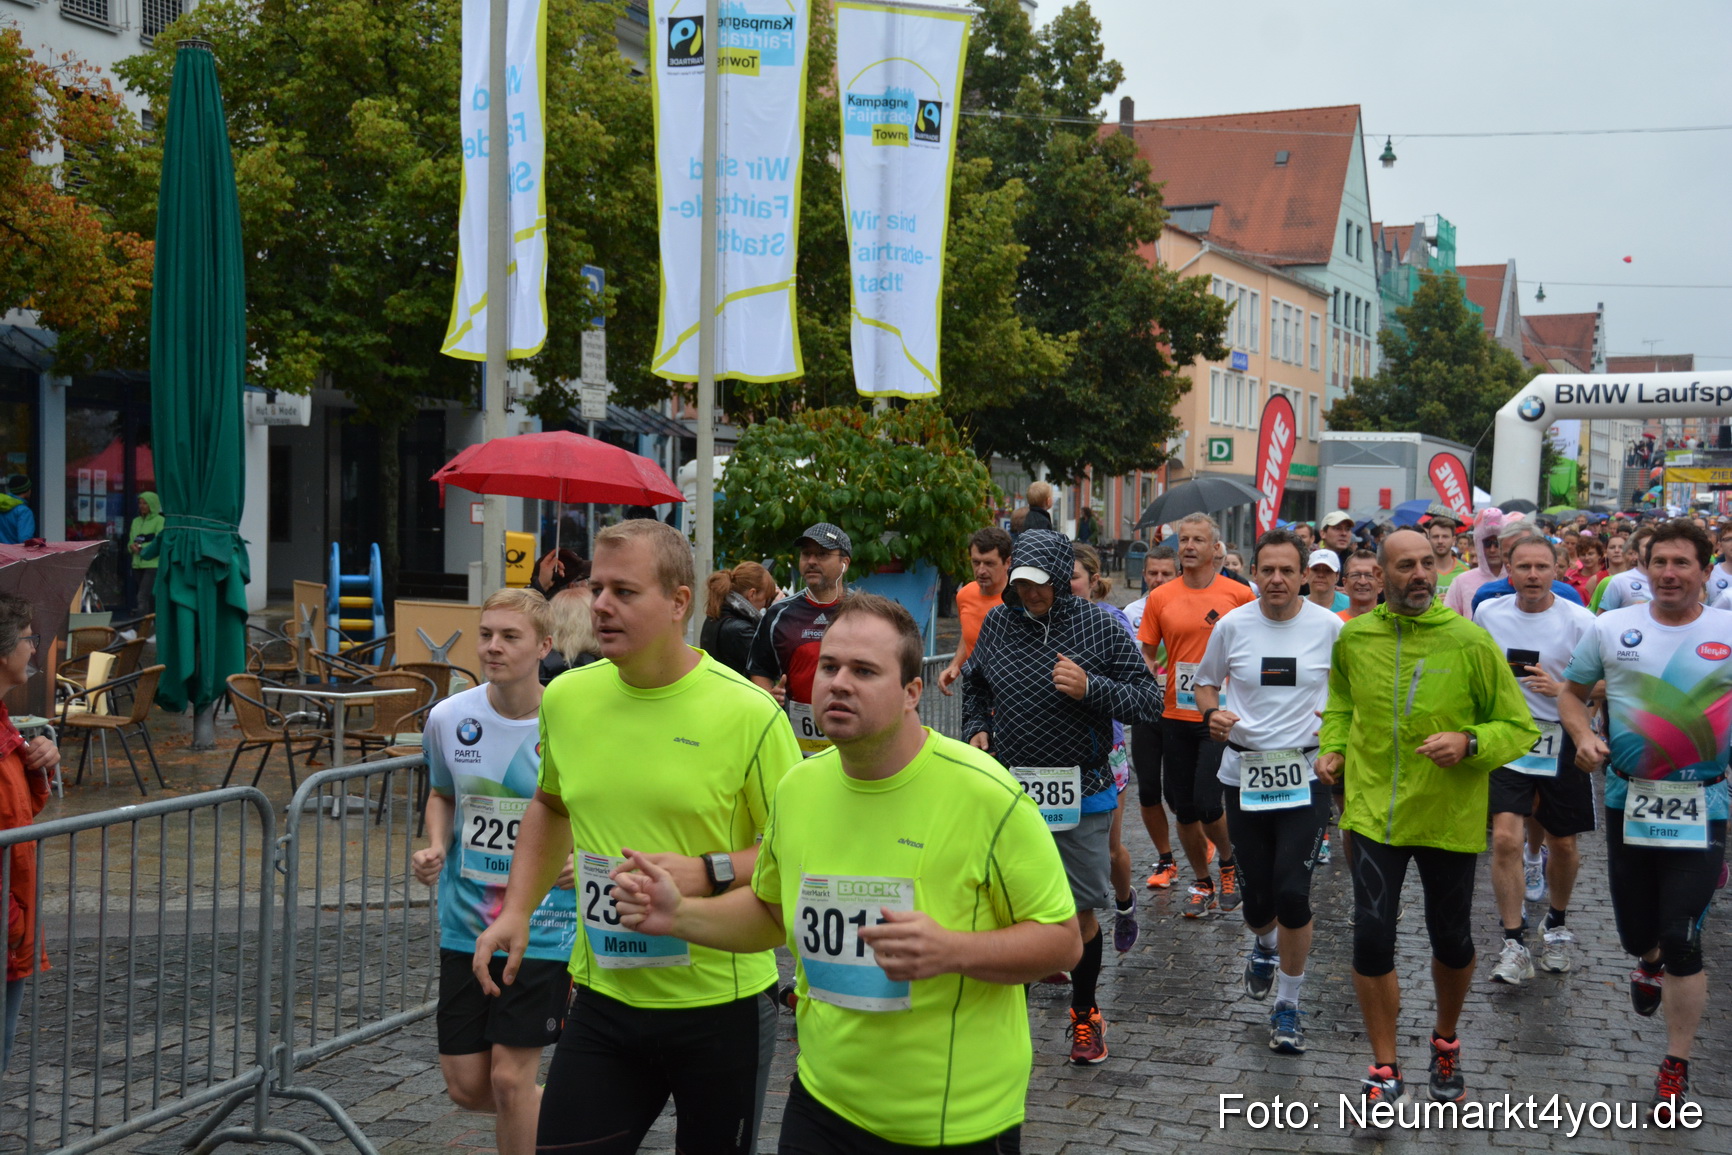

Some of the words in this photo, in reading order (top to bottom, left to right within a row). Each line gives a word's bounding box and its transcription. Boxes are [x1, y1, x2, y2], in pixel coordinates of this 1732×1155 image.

[847, 95, 908, 110] Kampagne
[847, 106, 912, 125] Fairtrade
[874, 129, 909, 142] Towns
[851, 210, 881, 231] Wir
[886, 210, 916, 234] sind
[853, 242, 933, 265] airtrade-
[1555, 383, 1630, 404] BMW
[1211, 441, 1229, 459] D
[1258, 412, 1291, 532] REWE
[1617, 650, 1640, 658] PARTL
[1700, 645, 1729, 657] Hervis
[454, 749, 482, 758] PARTL
[1529, 735, 1553, 756] 21
[1248, 763, 1302, 789] 2550
[1679, 769, 1698, 781] 17.
[1261, 792, 1291, 803] Martin
[499, 801, 530, 812] BOC
[1632, 794, 1699, 822] 2424
[1649, 826, 1679, 838] Franz
[484, 856, 509, 872] Tobi
[837, 880, 901, 898] BOCK
[802, 905, 883, 958] 301
[604, 936, 648, 953] Manu
